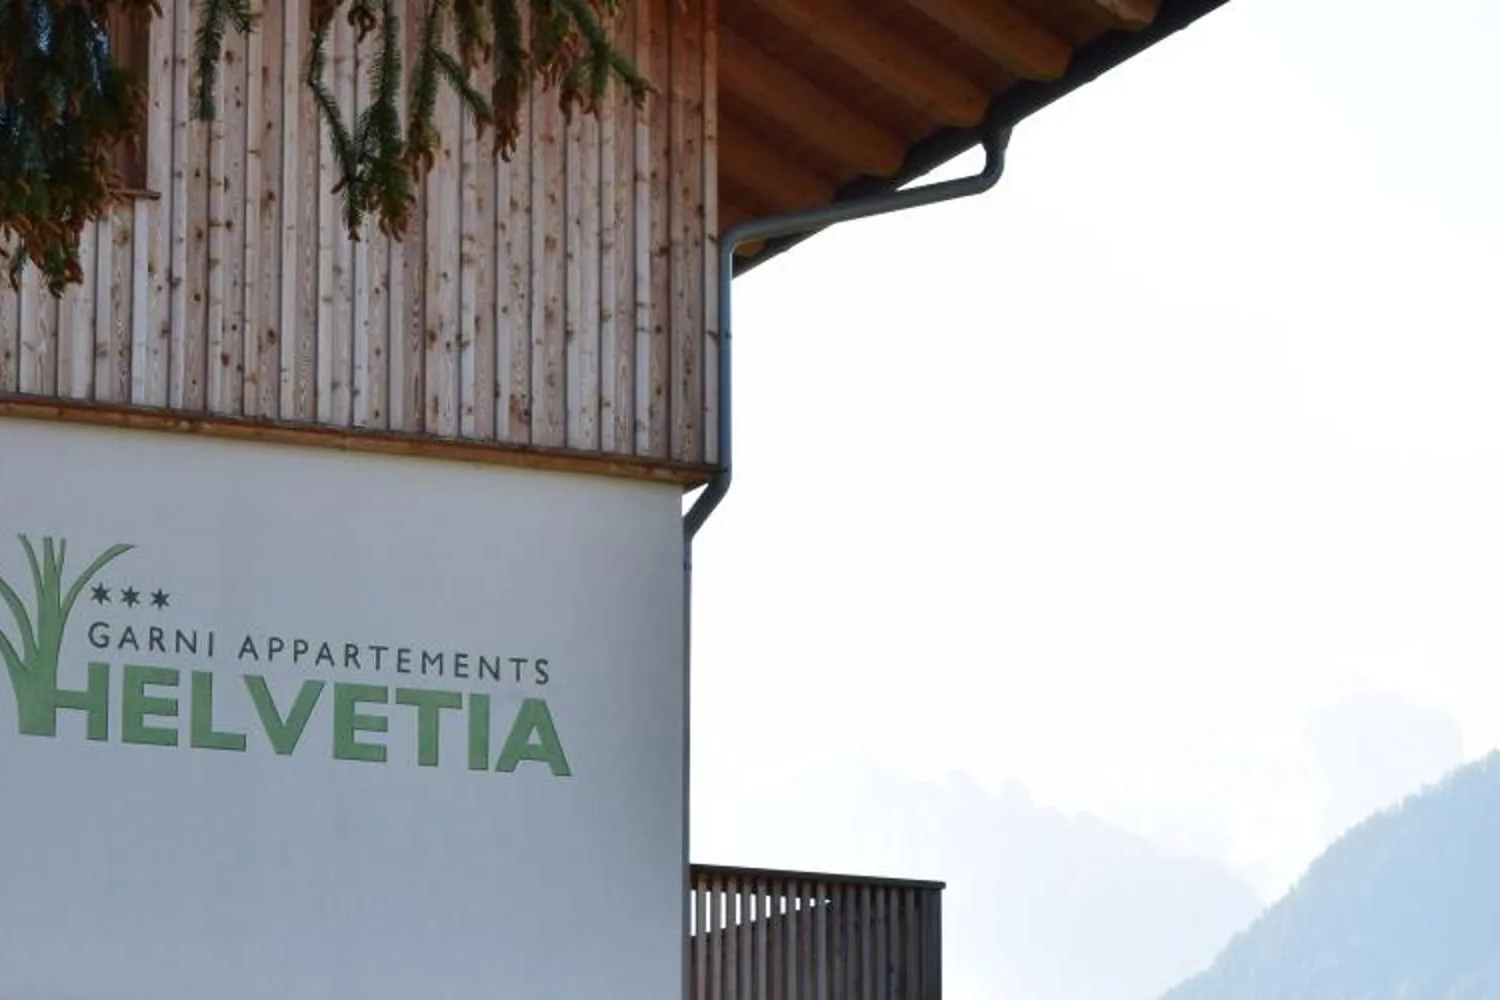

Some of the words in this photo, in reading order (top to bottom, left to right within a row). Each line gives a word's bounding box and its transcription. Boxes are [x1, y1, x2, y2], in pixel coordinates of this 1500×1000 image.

[88, 621, 215, 658] GARNI
[237, 635, 550, 686] APPARTEMENTS
[18, 661, 572, 777] HELVETIA
